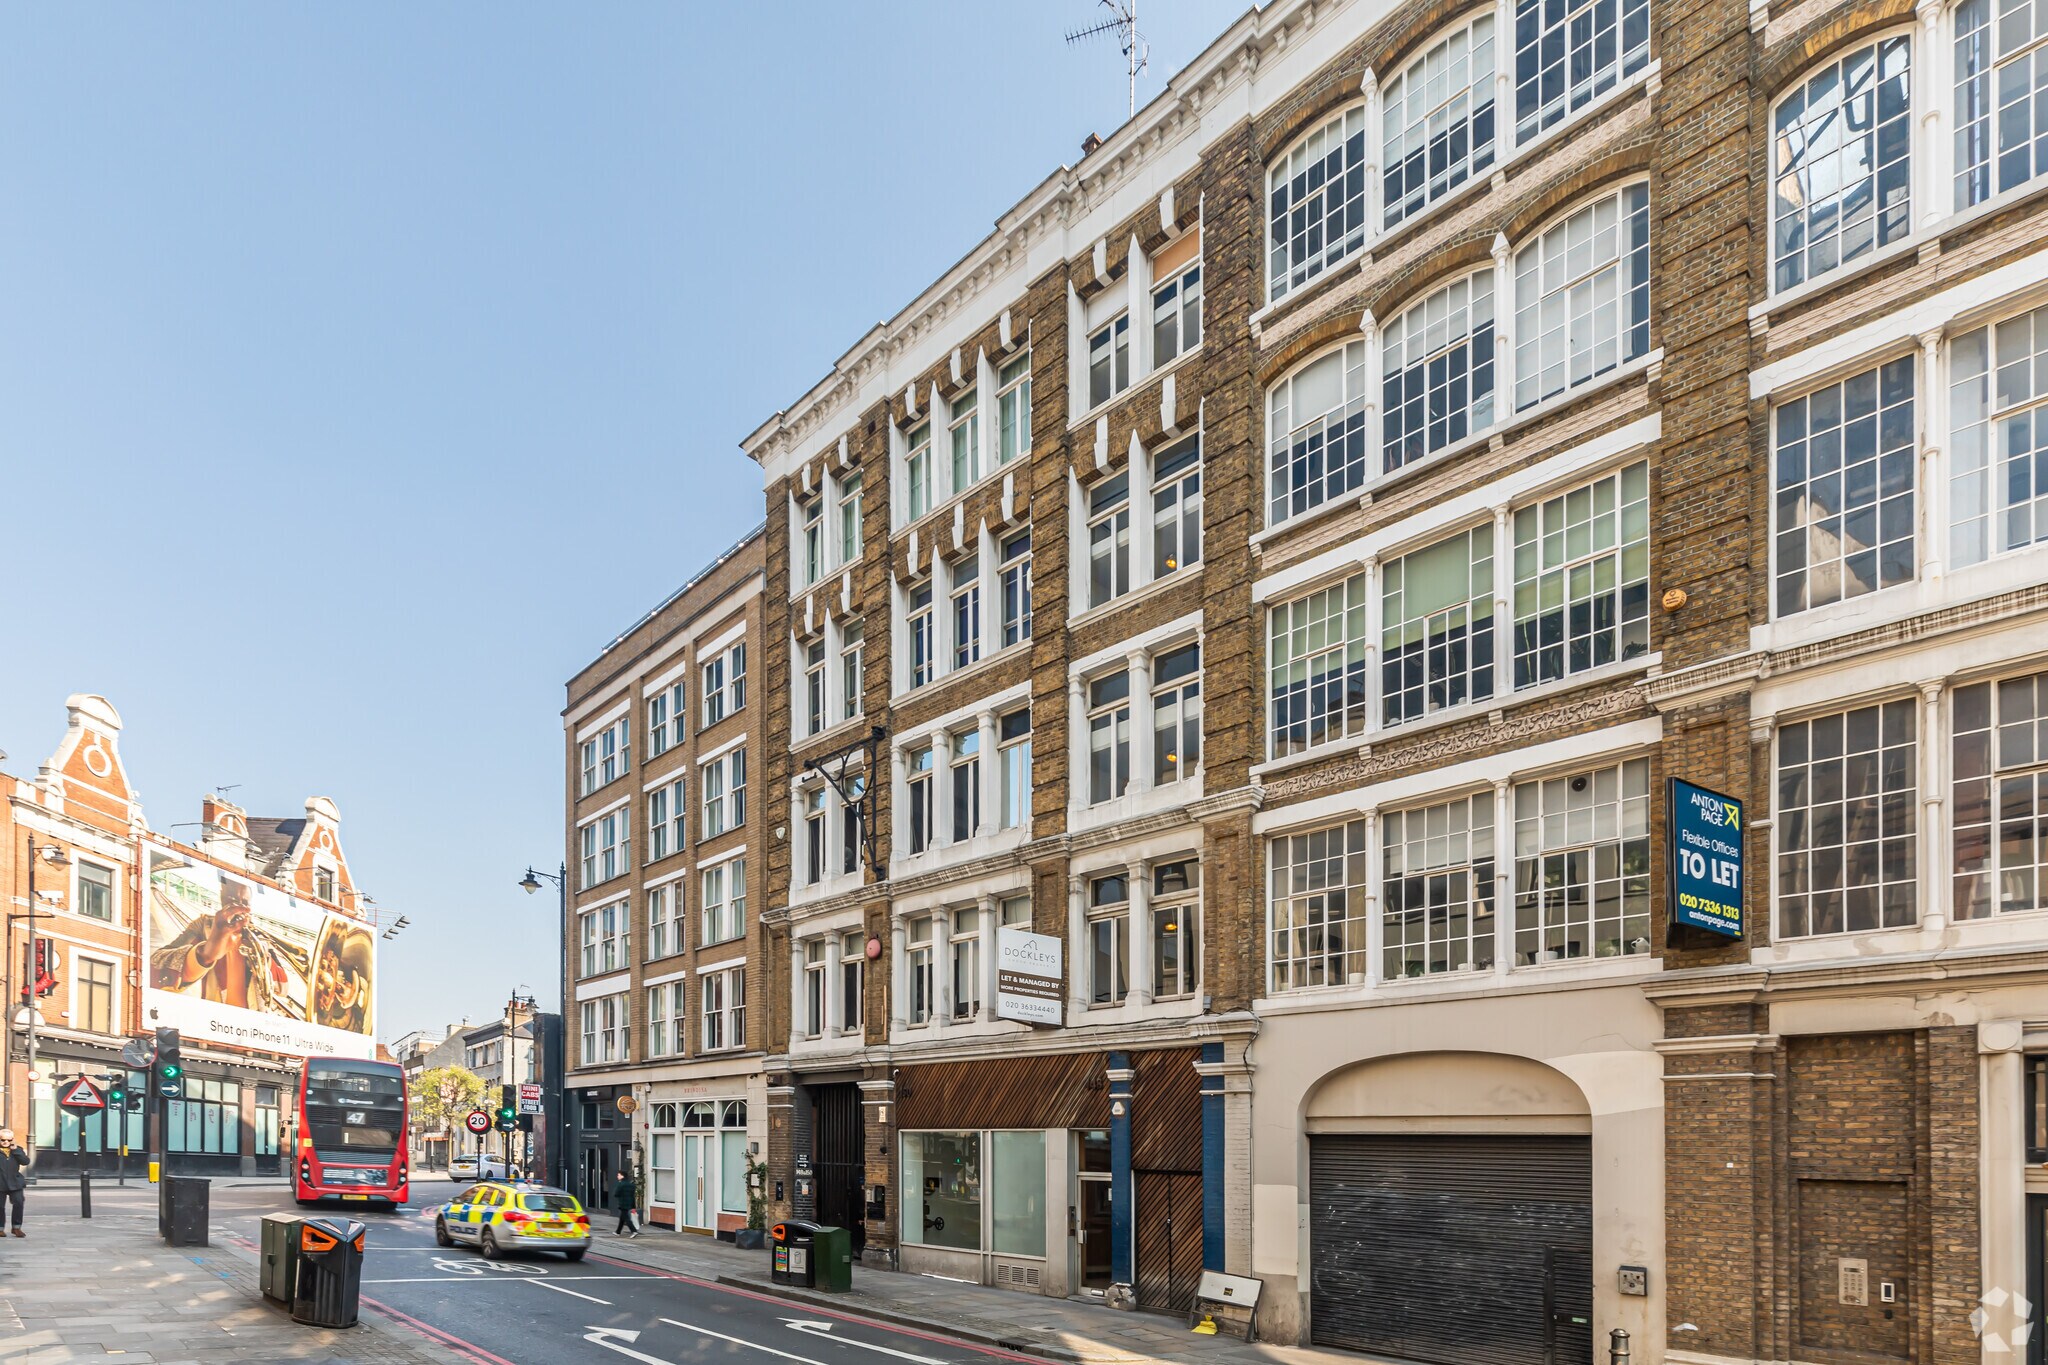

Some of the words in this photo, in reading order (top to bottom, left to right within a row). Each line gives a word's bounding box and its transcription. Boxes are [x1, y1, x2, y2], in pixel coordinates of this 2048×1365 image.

[1691, 792, 1723, 814] ANTON
[1701, 807, 1723, 827] PAGE
[1682, 828, 1710, 849] Flexible
[1711, 839, 1739, 858] Offices
[1680, 848, 1706, 880] TO
[1711, 858, 1739, 889] LET
[1680, 893, 1698, 909] 020
[1698, 897, 1721, 915] 7336
[1722, 904, 1740, 920] 1313
[1689, 911, 1740, 931] antonpage.com
[1005, 948, 1056, 963] DOCKLEYS
[1014, 986, 1039, 994] PROPERTIES
[1019, 978, 1050, 987] MANAGED
[1006, 1001, 1019, 1009] 020
[1021, 1003, 1055, 1013] 36334440
[210, 1020, 234, 1035] Shot
[235, 1027, 248, 1038] on
[250, 1028, 282, 1044] iPhone
[282, 1034, 290, 1046] 11
[294, 1037, 314, 1050] Ultra
[315, 1041, 335, 1054] Wide
[346, 1112, 366, 1124] 47
[470, 1117, 486, 1126] 20
[449, 1225, 478, 1236] POLICE
